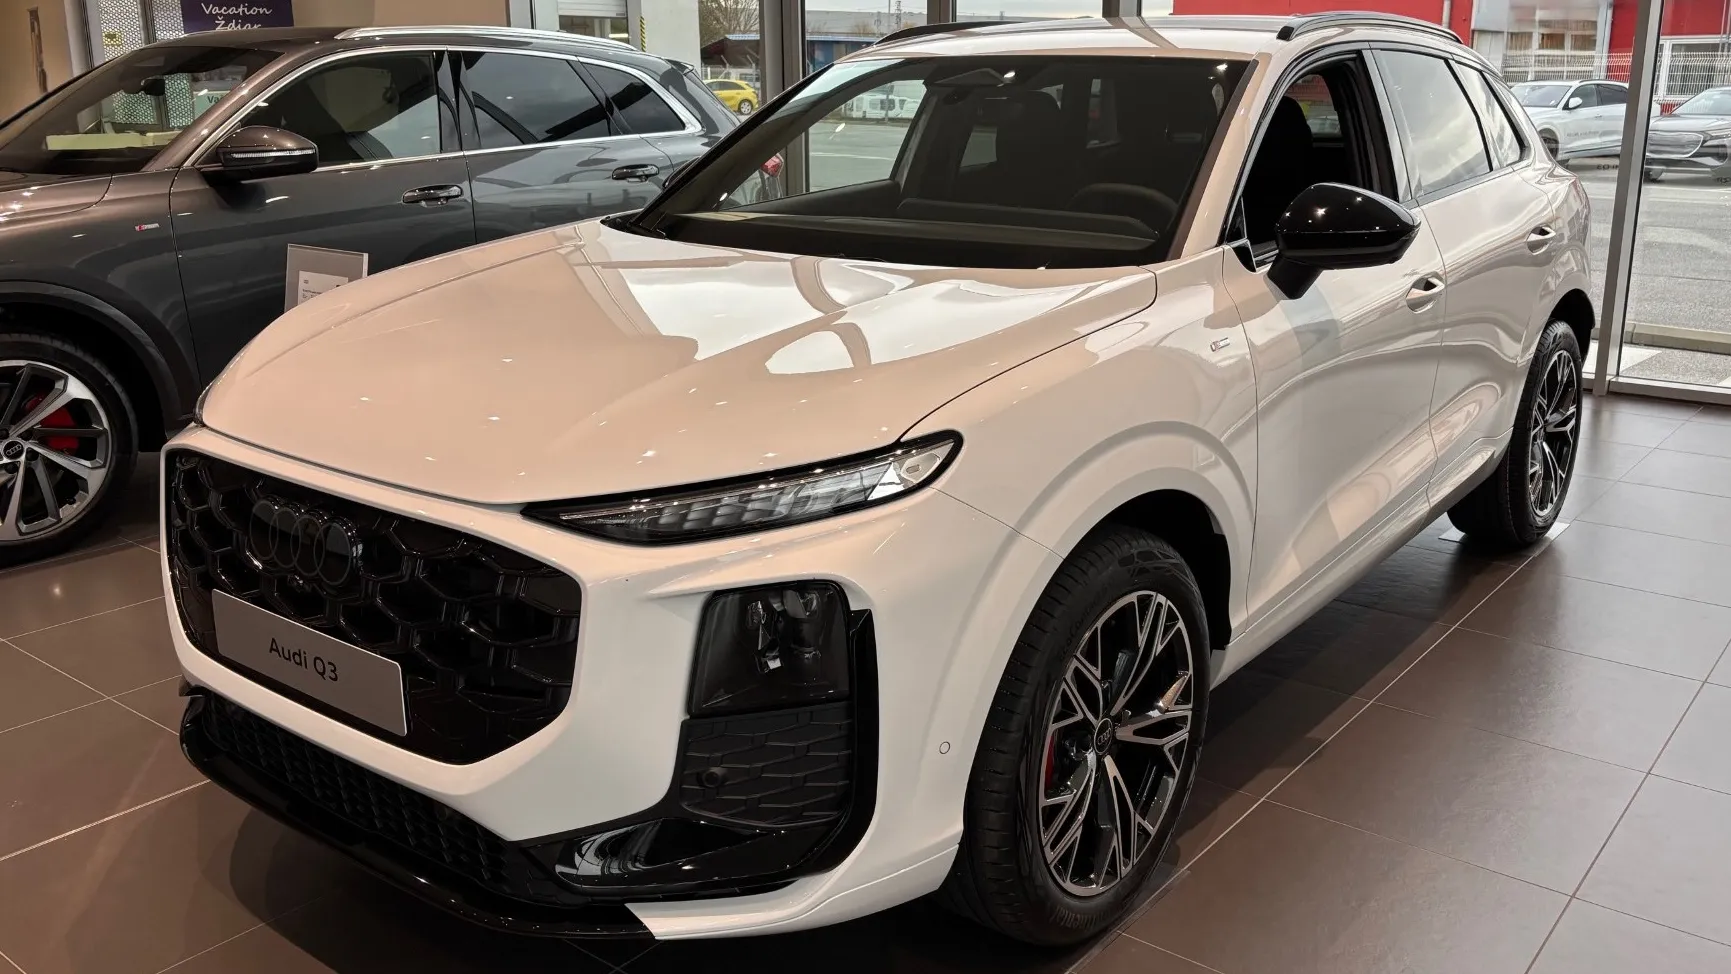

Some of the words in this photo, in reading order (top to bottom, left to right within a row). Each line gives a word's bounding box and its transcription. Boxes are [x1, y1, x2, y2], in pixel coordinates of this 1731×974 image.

[201, 3, 272, 15] Vacation
[215, 16, 262, 30] Ždiar
[269, 637, 308, 669] Audi
[313, 656, 338, 681] Q3
